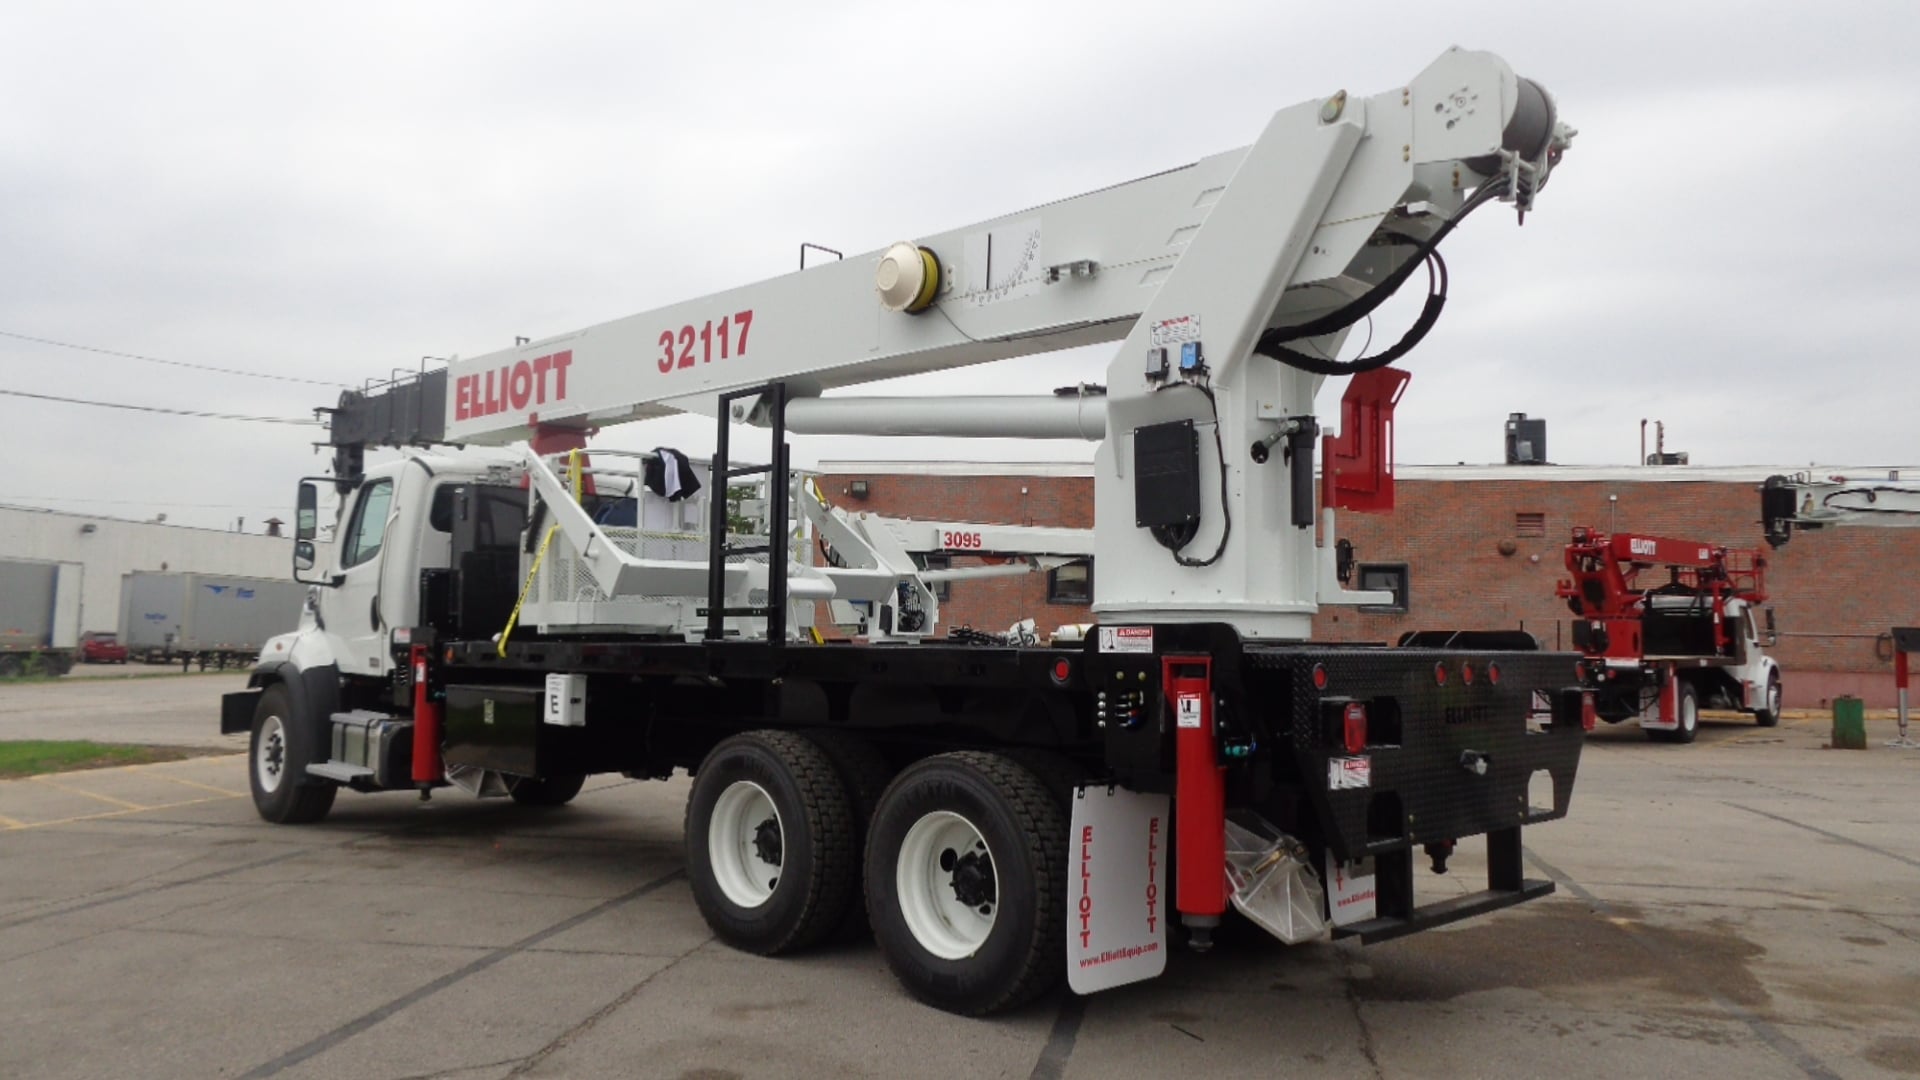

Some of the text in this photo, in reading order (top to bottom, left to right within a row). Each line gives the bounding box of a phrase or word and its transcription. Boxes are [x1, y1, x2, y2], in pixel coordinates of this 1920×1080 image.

[657, 310, 753, 373] 32117
[455, 350, 573, 421] ELLIOTT
[944, 532, 981, 548] 3095
[1079, 826, 1093, 948] ELLIOTT
[1146, 818, 1159, 933] ELLIOTT
[1080, 942, 1158, 968] www.ElliottEquip.com
